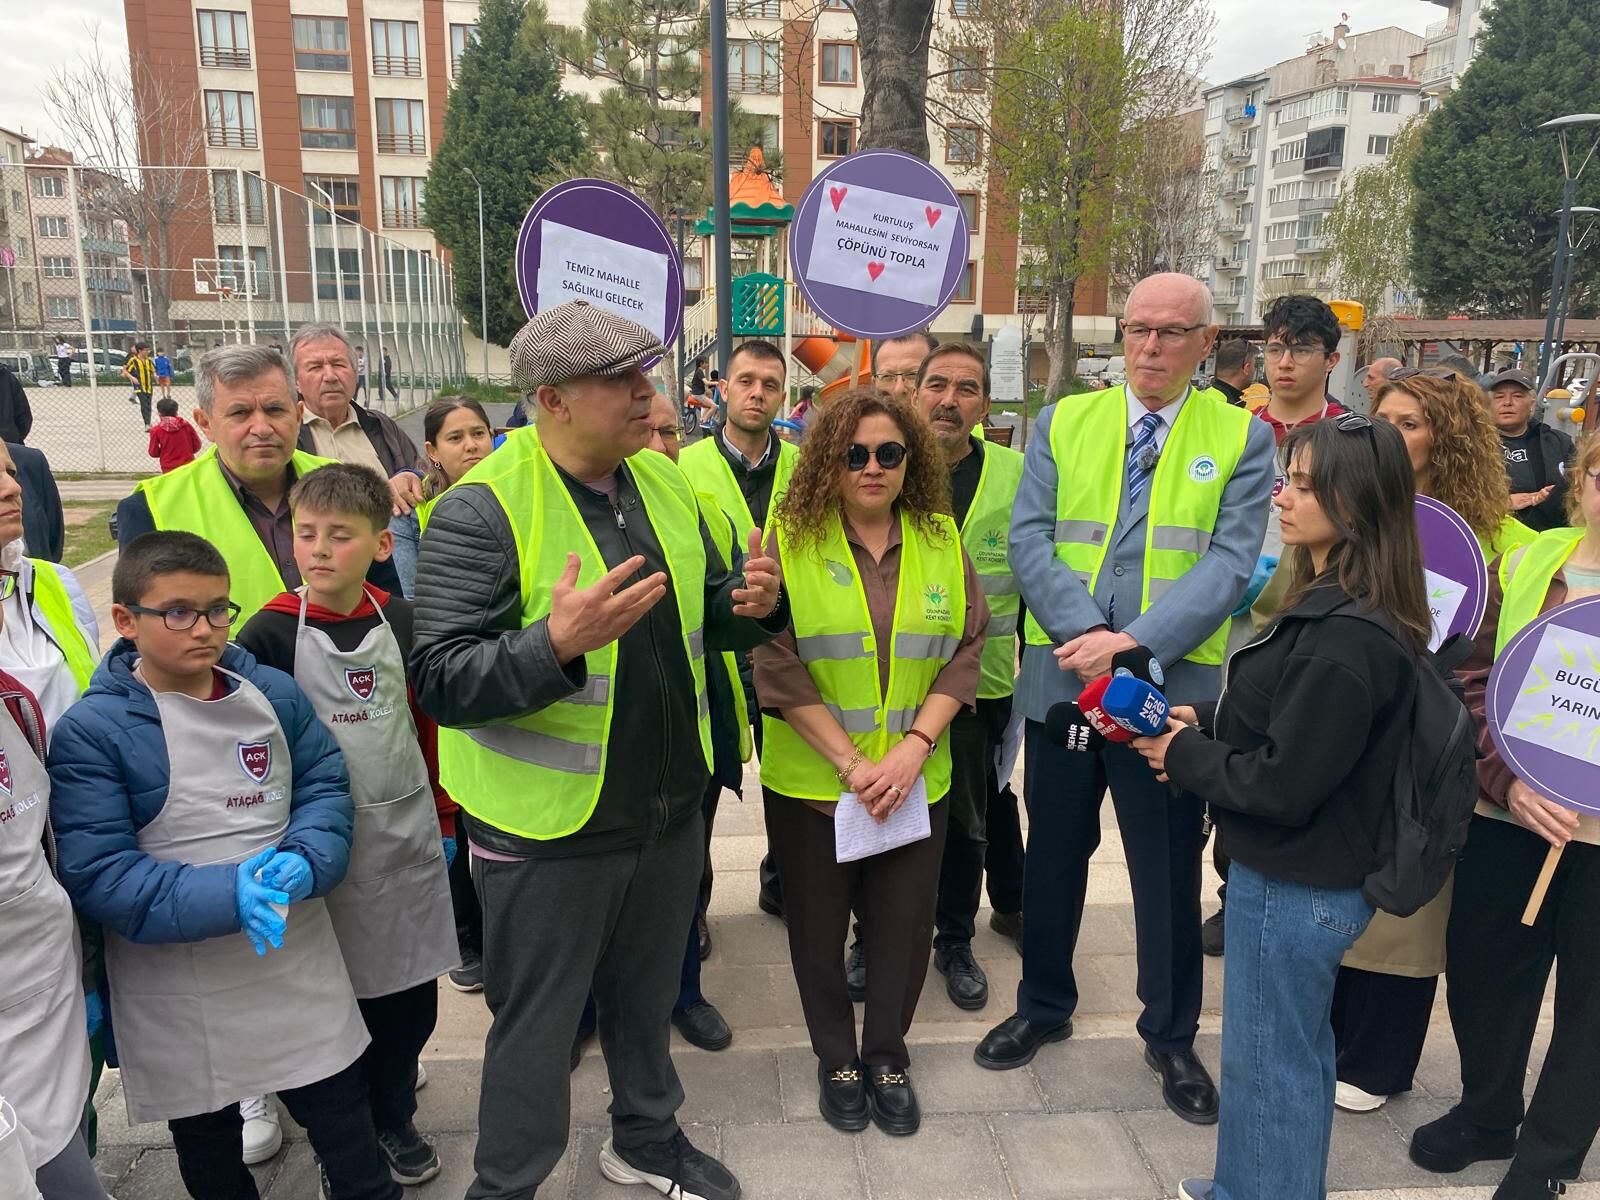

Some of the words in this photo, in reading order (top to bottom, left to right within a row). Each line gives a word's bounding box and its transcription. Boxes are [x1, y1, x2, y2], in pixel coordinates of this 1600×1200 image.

[872, 213, 914, 230] KURTULUŞ
[835, 220, 889, 240] MAHALLESİNİ
[891, 234, 940, 252] SEVİYORSAN
[837, 238, 888, 259] ÇÖPÜNÜ
[890, 251, 926, 269] TOPLA
[566, 261, 595, 278] TEMİZ
[597, 270, 641, 290] MAHALLE
[562, 279, 603, 299] SAĞLIKLI
[605, 292, 644, 311] GELECEK
[352, 674, 371, 684] AÇK
[1139, 692, 1156, 718] NET
[1150, 701, 1166, 728] 26
[246, 751, 266, 762] AÇK
